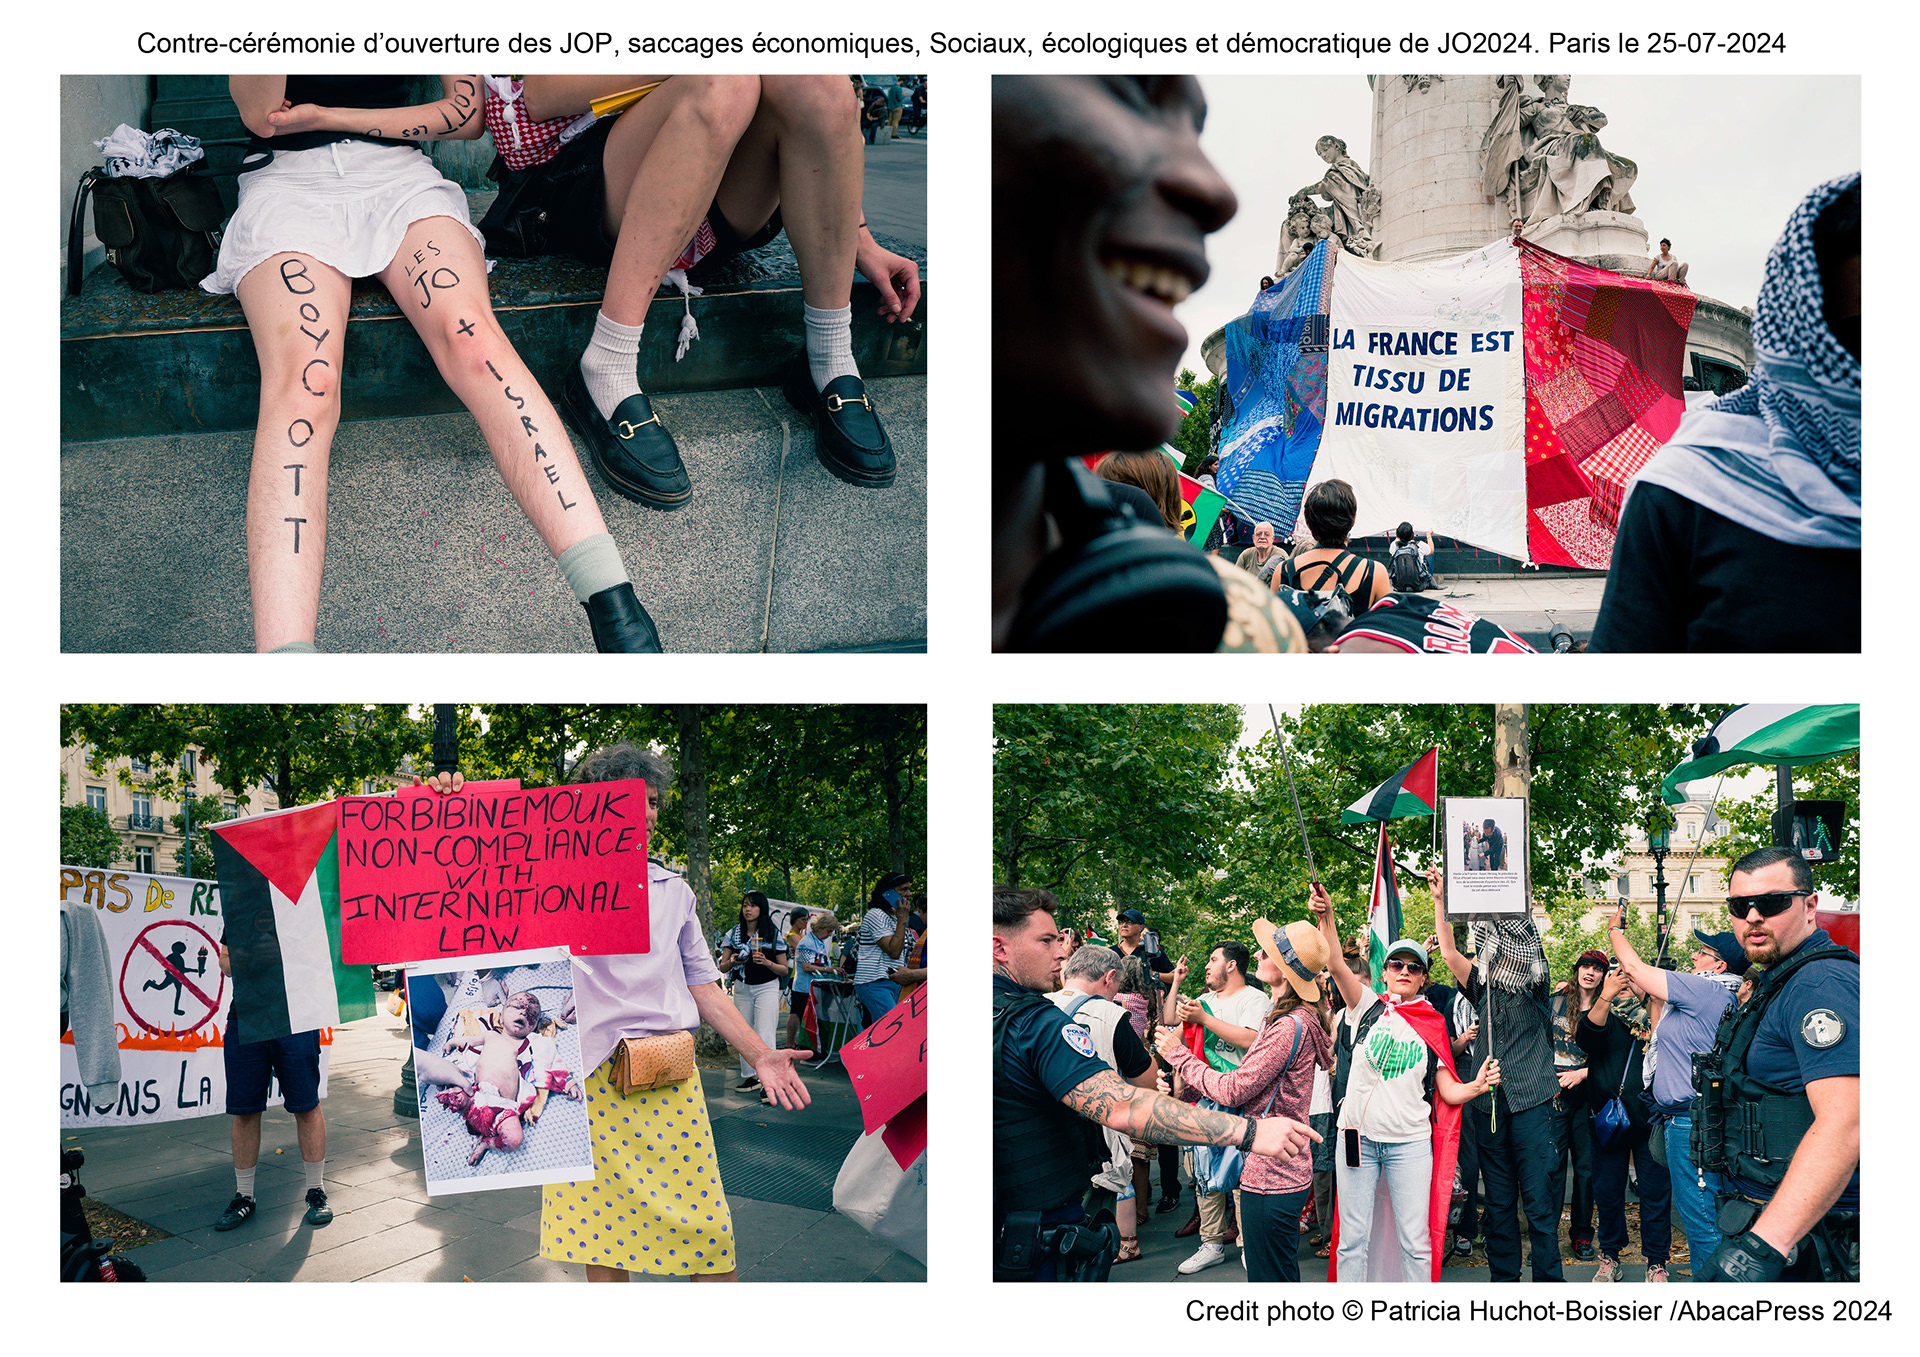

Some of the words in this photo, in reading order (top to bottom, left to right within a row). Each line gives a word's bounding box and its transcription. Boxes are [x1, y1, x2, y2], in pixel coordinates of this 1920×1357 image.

[404, 240, 441, 277] LES
[413, 267, 460, 309] JO
[1332, 327, 1356, 351] LA
[1368, 331, 1458, 357] FRANCE
[1471, 330, 1515, 354] EST
[1352, 364, 1425, 394] TISSU
[1438, 367, 1471, 392] DE
[280, 259, 331, 553] BOYCOTT
[1335, 401, 1494, 433] MIGRATIONS
[485, 360, 577, 511] ISRAEL
[61, 869, 133, 913] PAS
[439, 924, 519, 952] LAW
